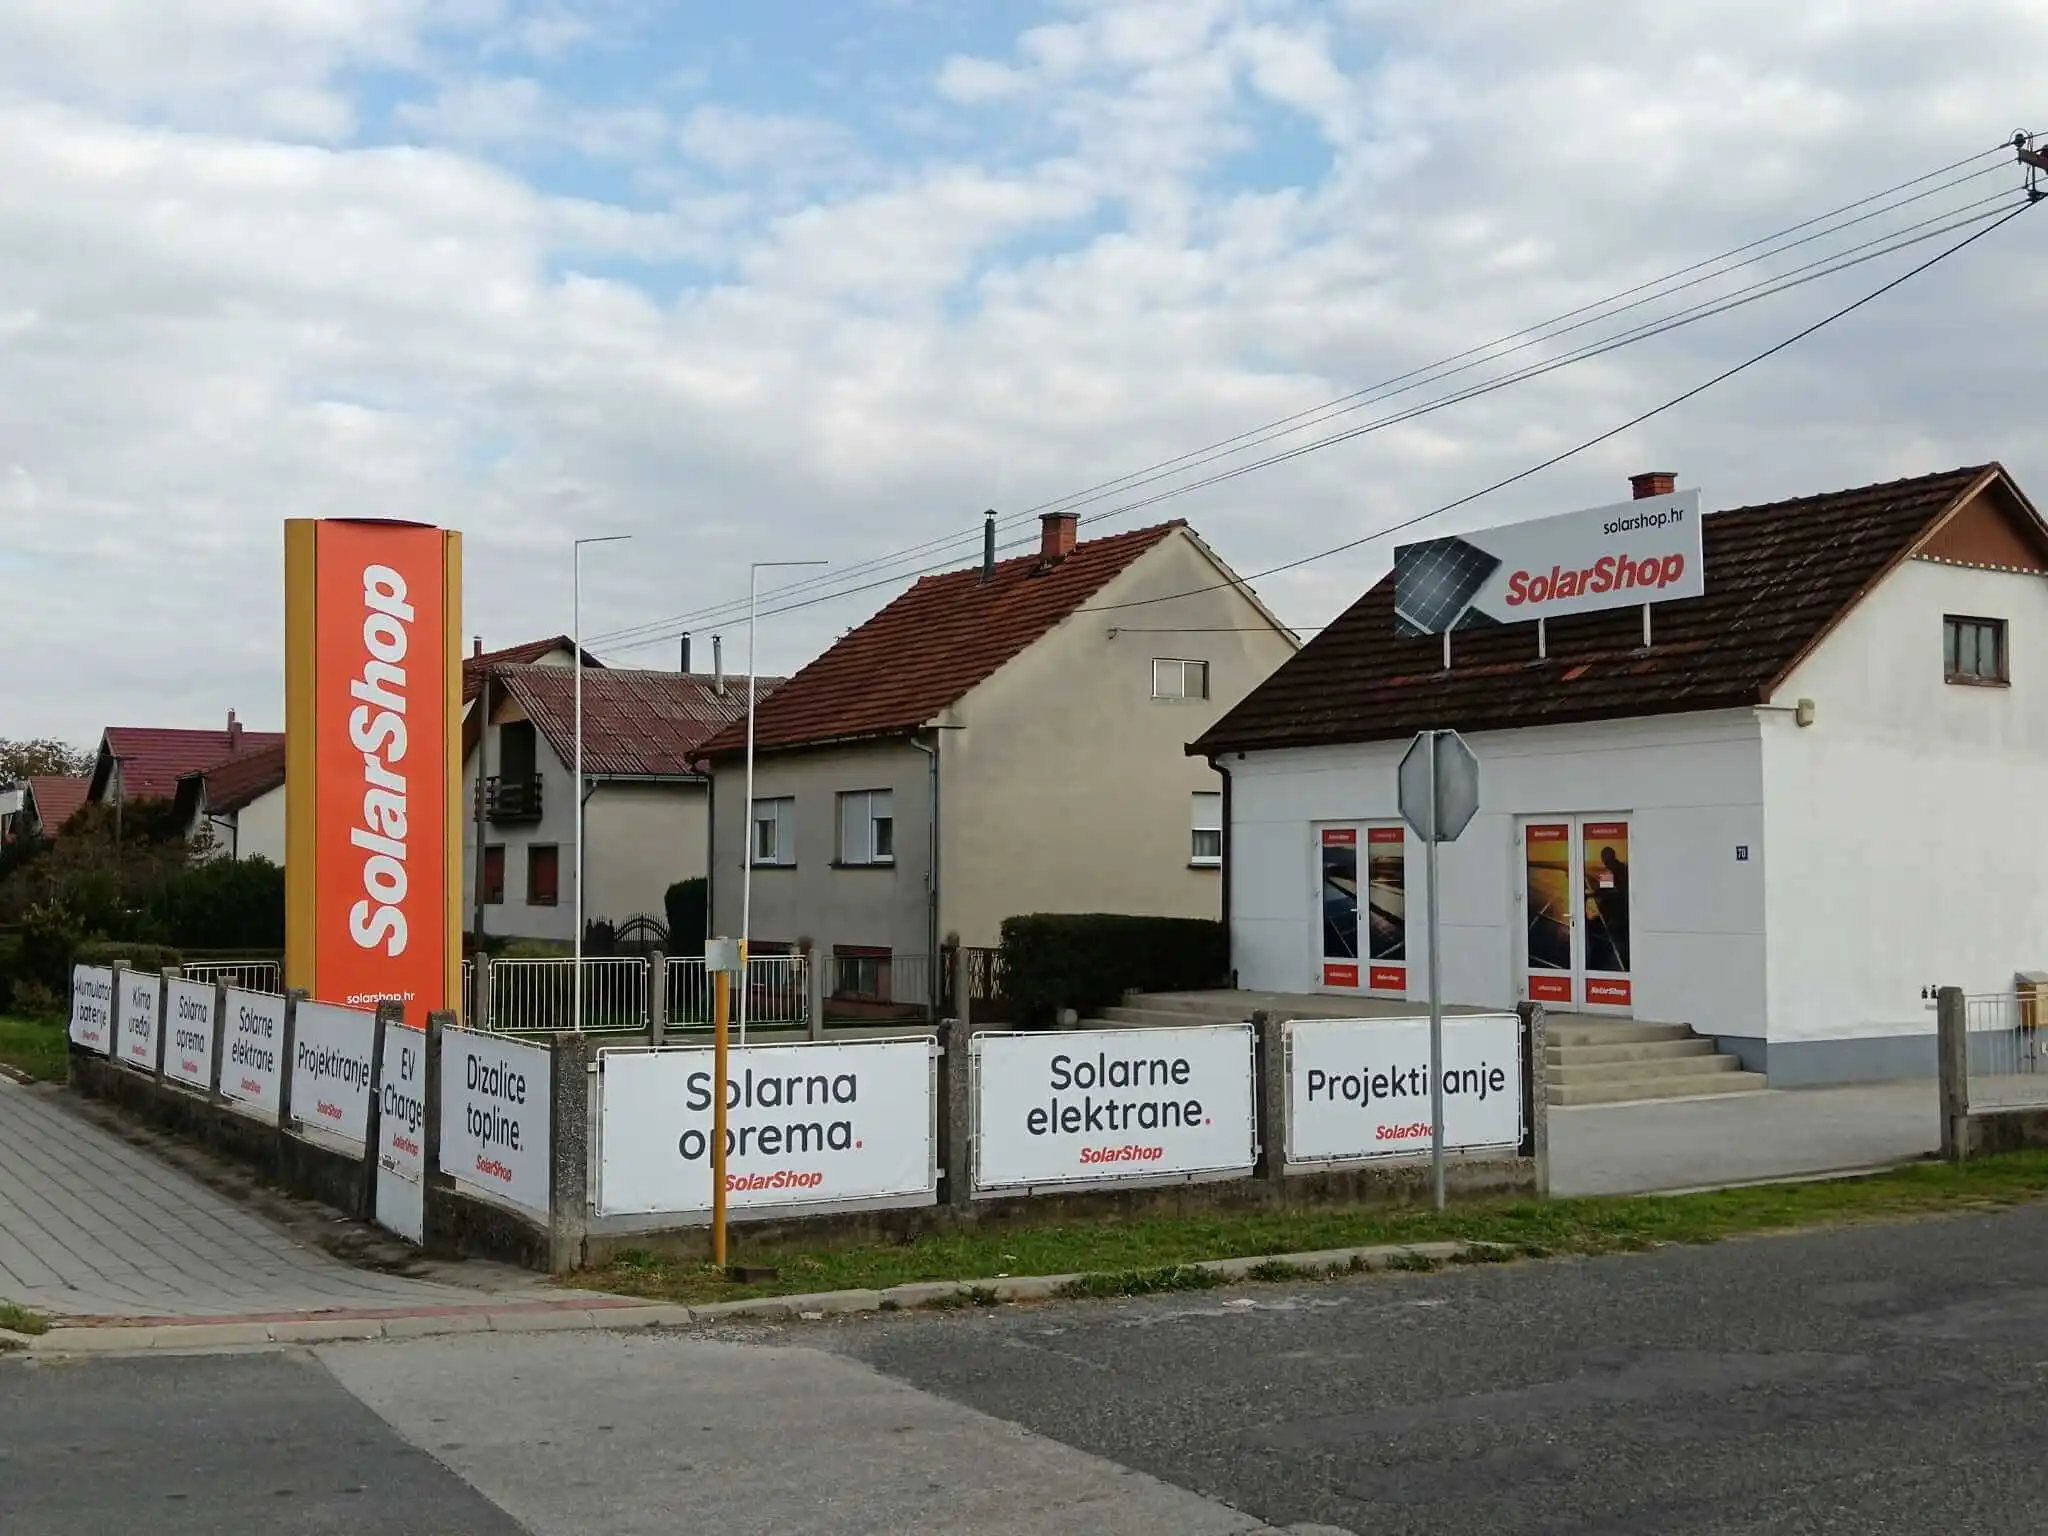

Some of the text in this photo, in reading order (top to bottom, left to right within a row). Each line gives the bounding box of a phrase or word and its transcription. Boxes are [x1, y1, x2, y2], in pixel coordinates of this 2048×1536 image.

[1603, 507, 1685, 535] solarshop.hr
[1505, 552, 1685, 607] SolarShop
[348, 563, 415, 957] SolarShop
[179, 995, 207, 1023] Solarna
[239, 1005, 273, 1039] Solarne
[298, 1042, 369, 1093] Projektiranje
[401, 1047, 416, 1081] EV
[466, 1053, 526, 1105] Dizalice
[1050, 1052, 1191, 1091] Solarne
[1307, 1061, 1505, 1108] Projektianje
[466, 1101, 524, 1152] topline.
[1026, 1095, 1212, 1135] elektrane.
[475, 1154, 512, 1183] SolarShop
[1079, 1144, 1163, 1164] SolarShop
[725, 1169, 824, 1193] SolarShop
